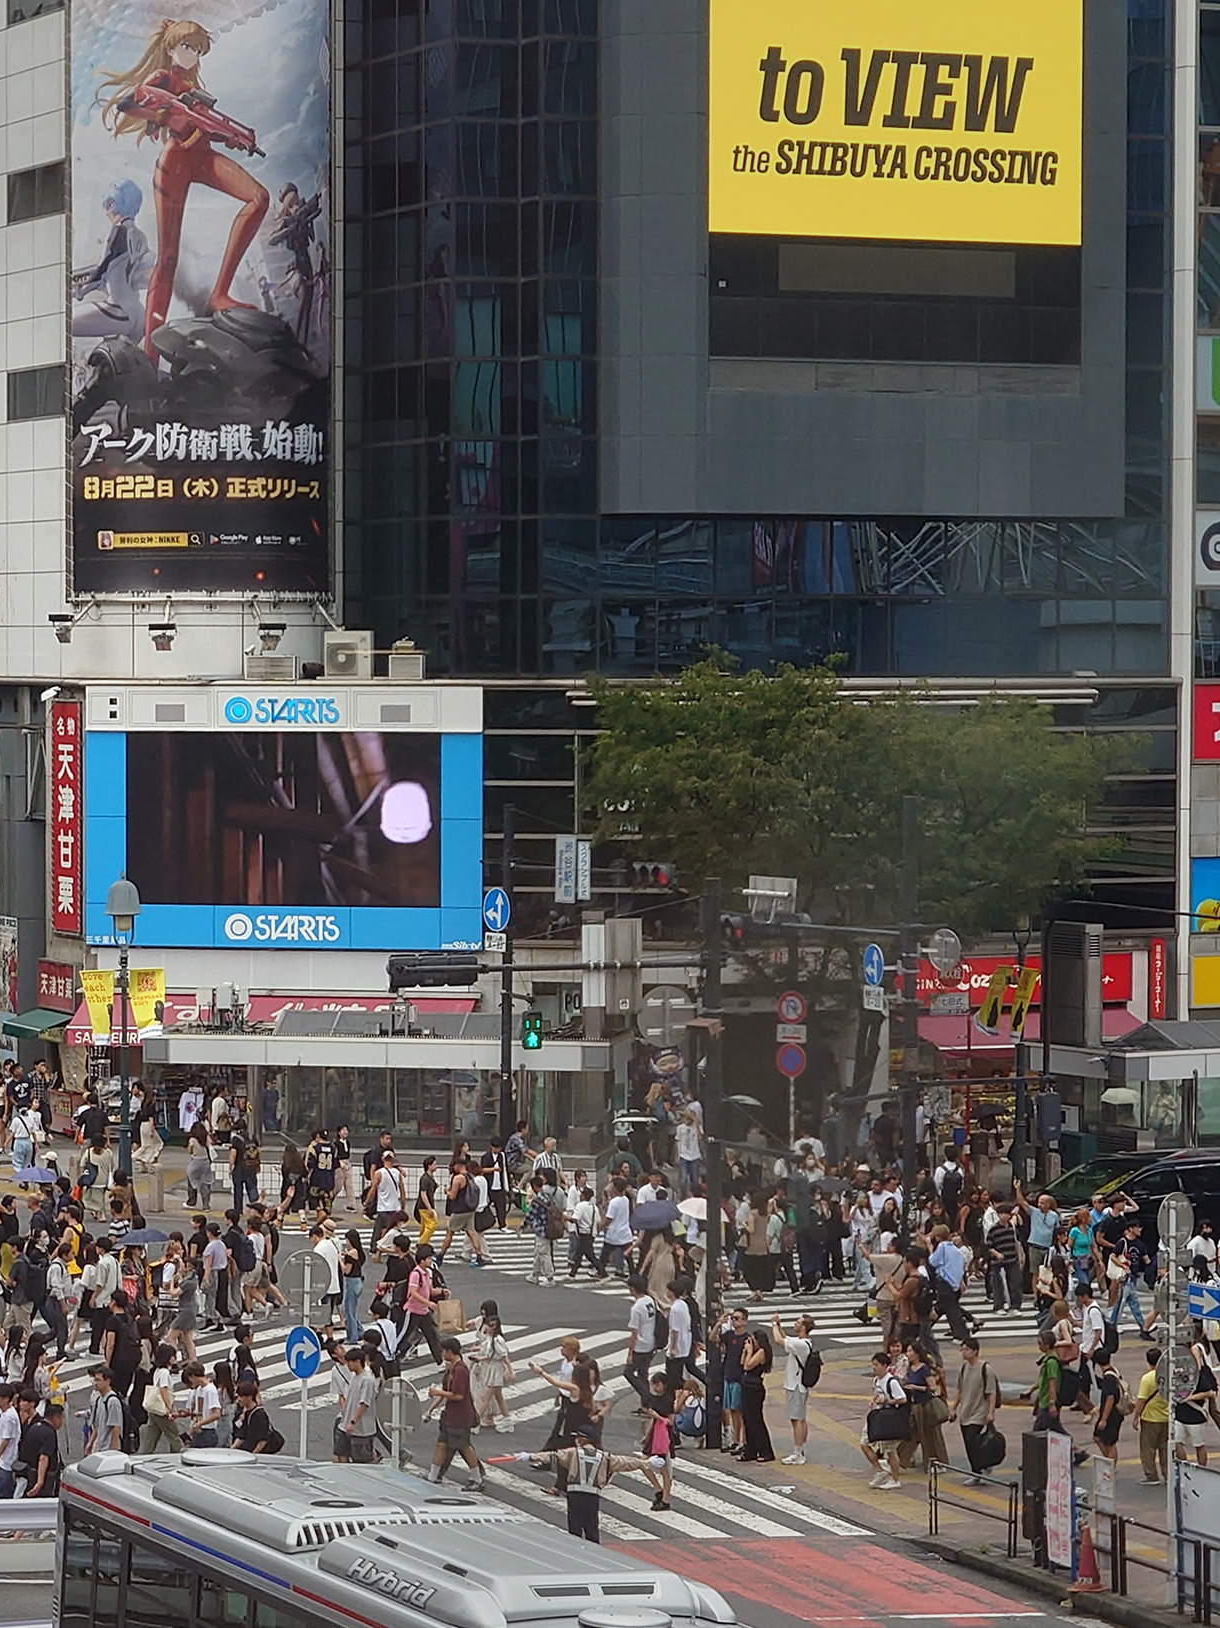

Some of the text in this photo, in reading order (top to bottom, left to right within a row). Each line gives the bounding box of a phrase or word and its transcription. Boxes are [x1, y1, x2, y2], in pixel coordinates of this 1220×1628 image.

[759, 45, 1035, 134] to VIEW
[732, 139, 1059, 188] the SHIBUYA CROSSING
[83, 475, 174, 500] 8月22日
[226, 476, 321, 499] 正式リリース
[255, 698, 340, 724] STARTS
[56, 716, 76, 736] 名物
[57, 744, 75, 914] 天津甘栗
[254, 915, 340, 941] STARTS
[39, 972, 73, 999] 天津甘栗
[346, 1556, 438, 1610] Hybrid
